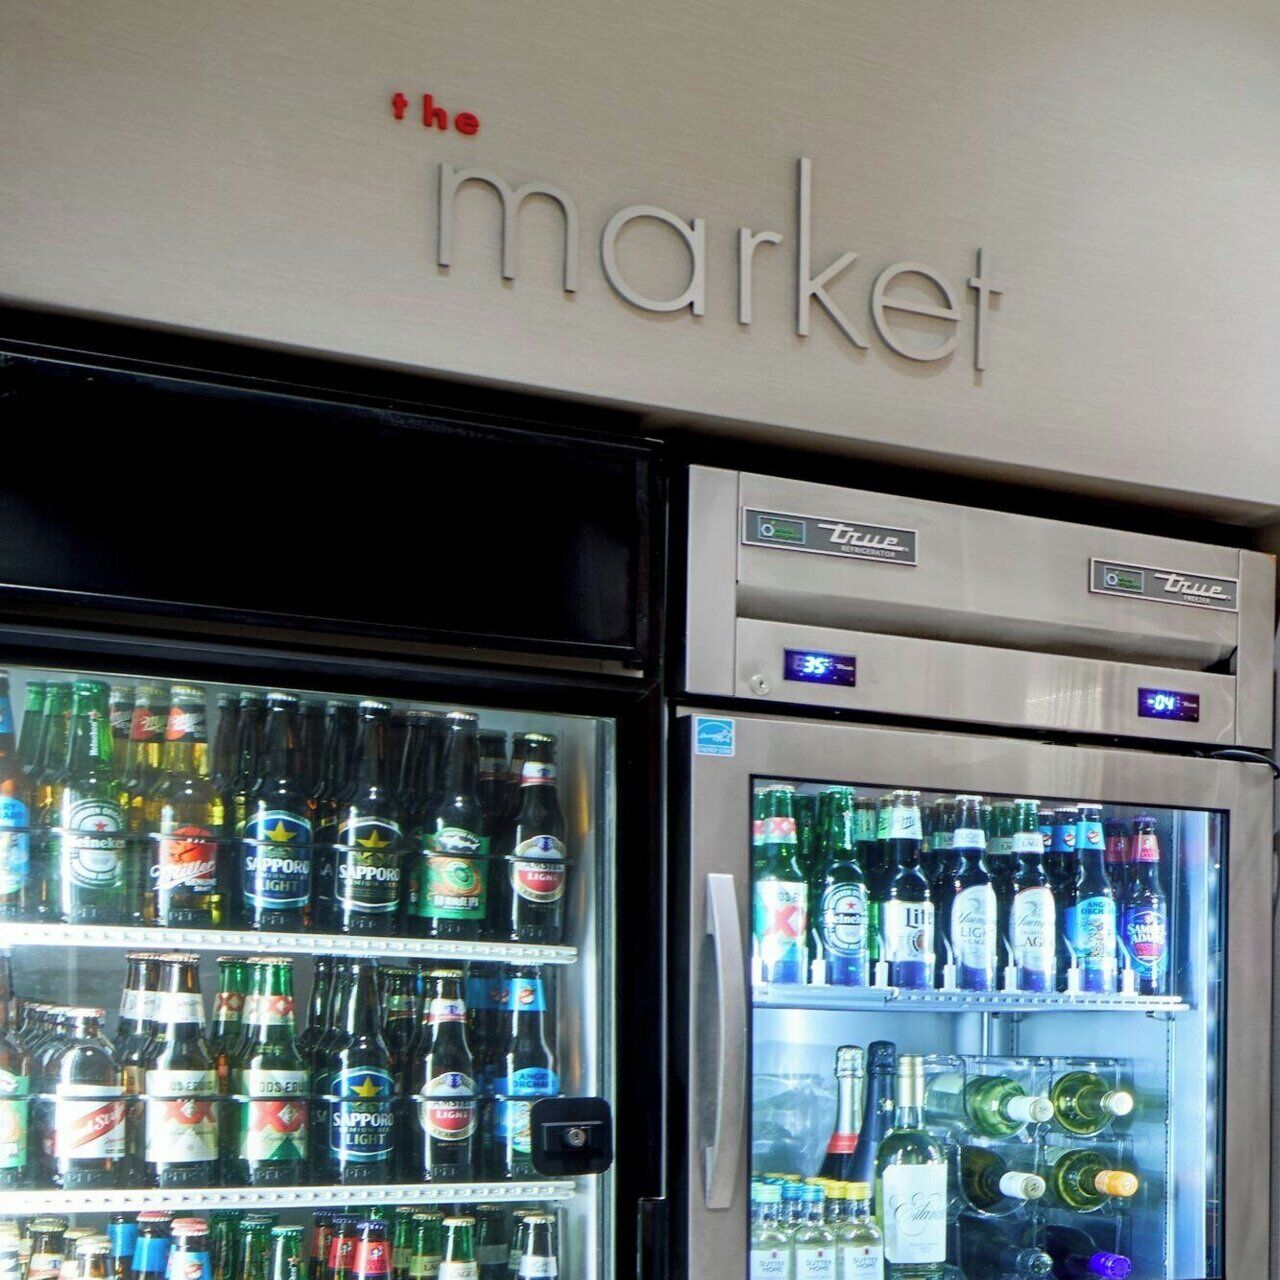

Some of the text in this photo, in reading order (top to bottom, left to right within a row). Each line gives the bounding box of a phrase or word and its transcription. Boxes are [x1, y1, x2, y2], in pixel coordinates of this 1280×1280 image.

[391, 91, 480, 137] the
[437, 156, 1005, 373] market
[841, 545, 896, 560] REFRIGERATOR
[246, 855, 312, 876] SAPPORO
[259, 877, 299, 895] LIGHT
[333, 1111, 396, 1133] SAPPORO
[344, 1132, 388, 1147] LIGHT
